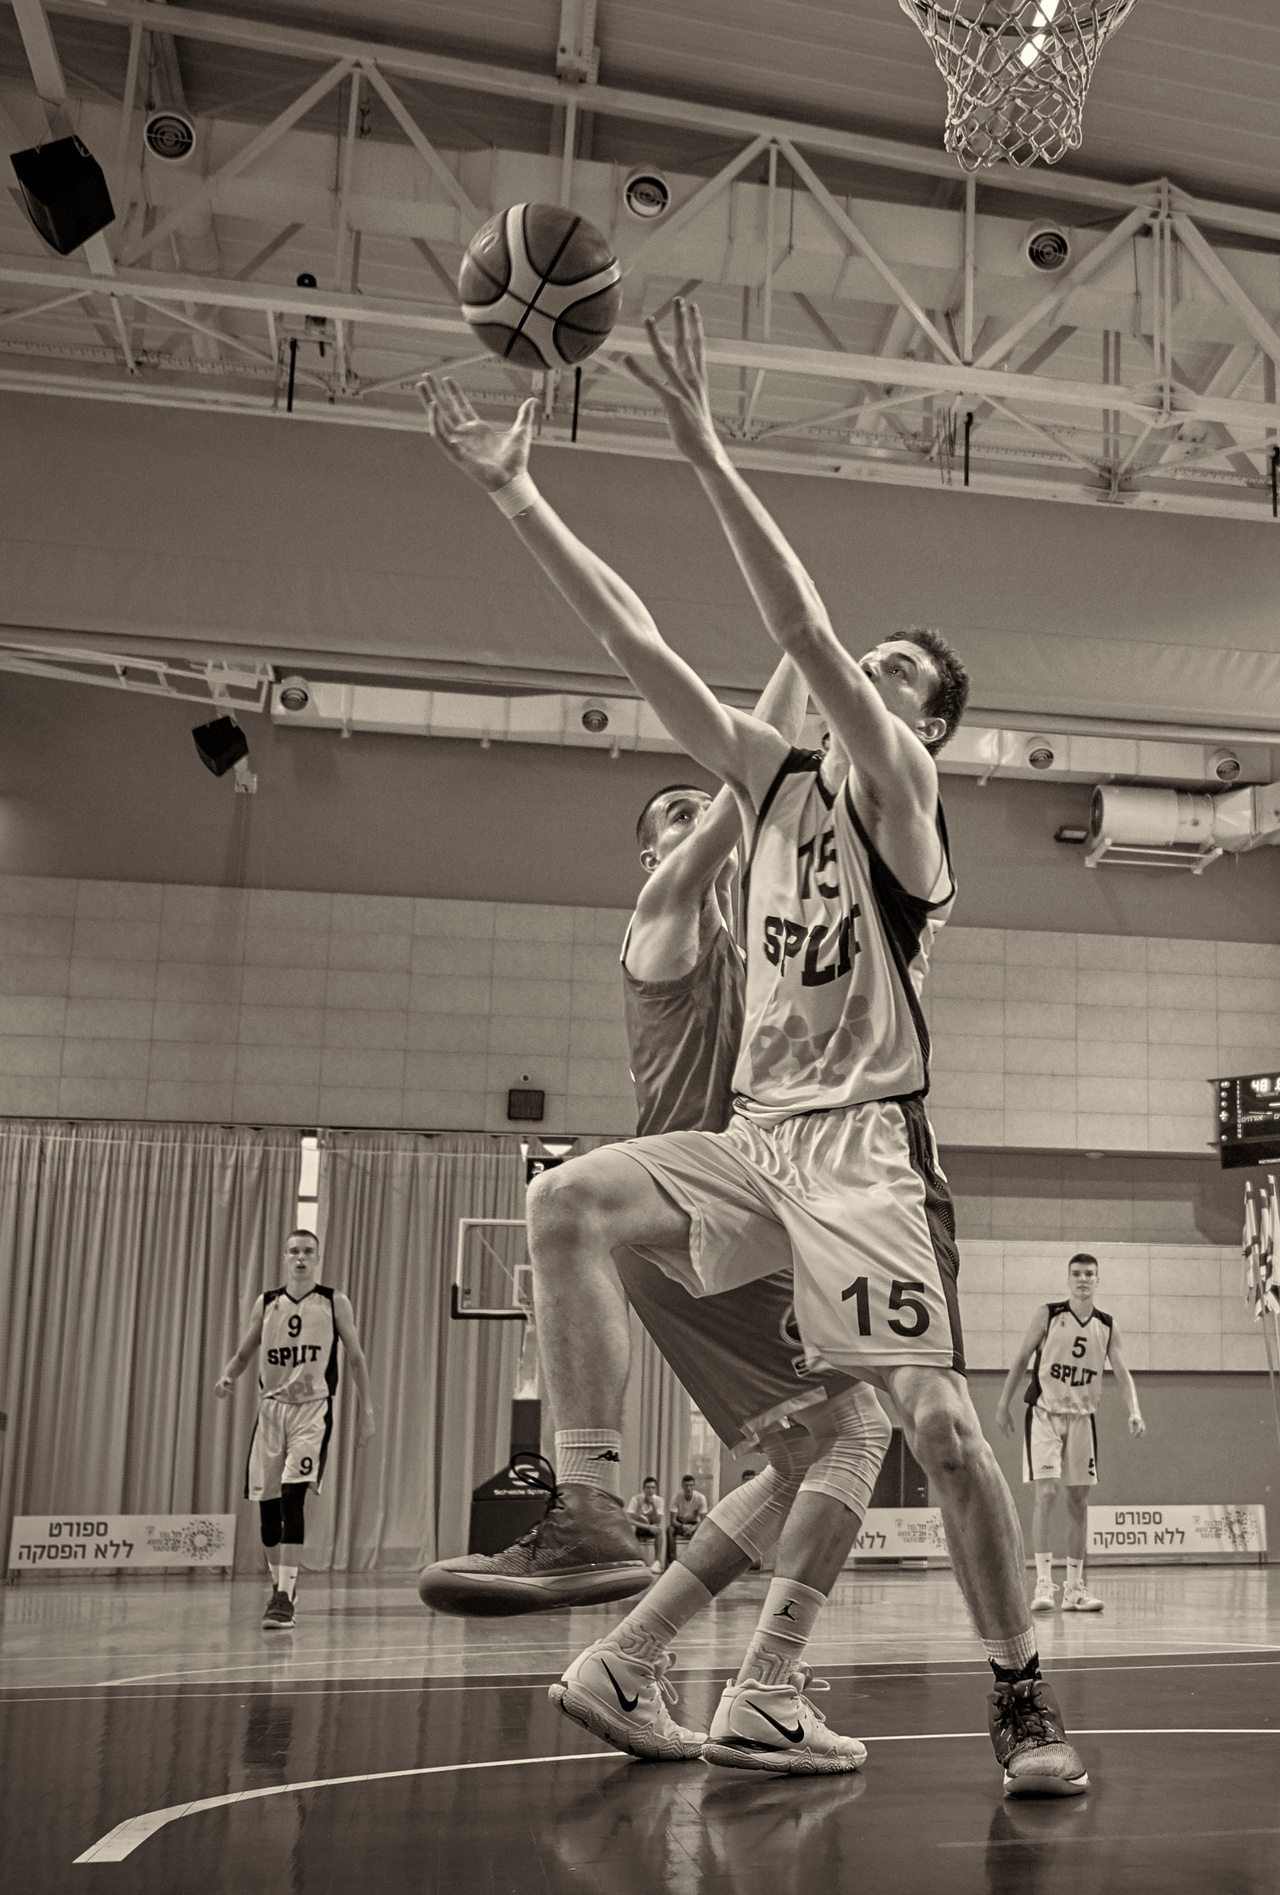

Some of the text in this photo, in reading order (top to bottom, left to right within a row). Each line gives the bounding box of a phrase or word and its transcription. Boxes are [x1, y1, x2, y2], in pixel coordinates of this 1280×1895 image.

[841, 1276, 931, 1338] 15
[287, 1314, 303, 1338] 9
[267, 1345, 321, 1368] SPLIT
[1071, 1336, 1088, 1359] 5
[1050, 1363, 1098, 1387] SPLIT
[300, 1456, 313, 1476] 9
[48, 1521, 109, 1538] ספורט
[1115, 1511, 1162, 1525] ספורט
[1093, 1528, 1185, 1549] ללא הפסקה
[17, 1539, 134, 1564] ללא הפסקה
